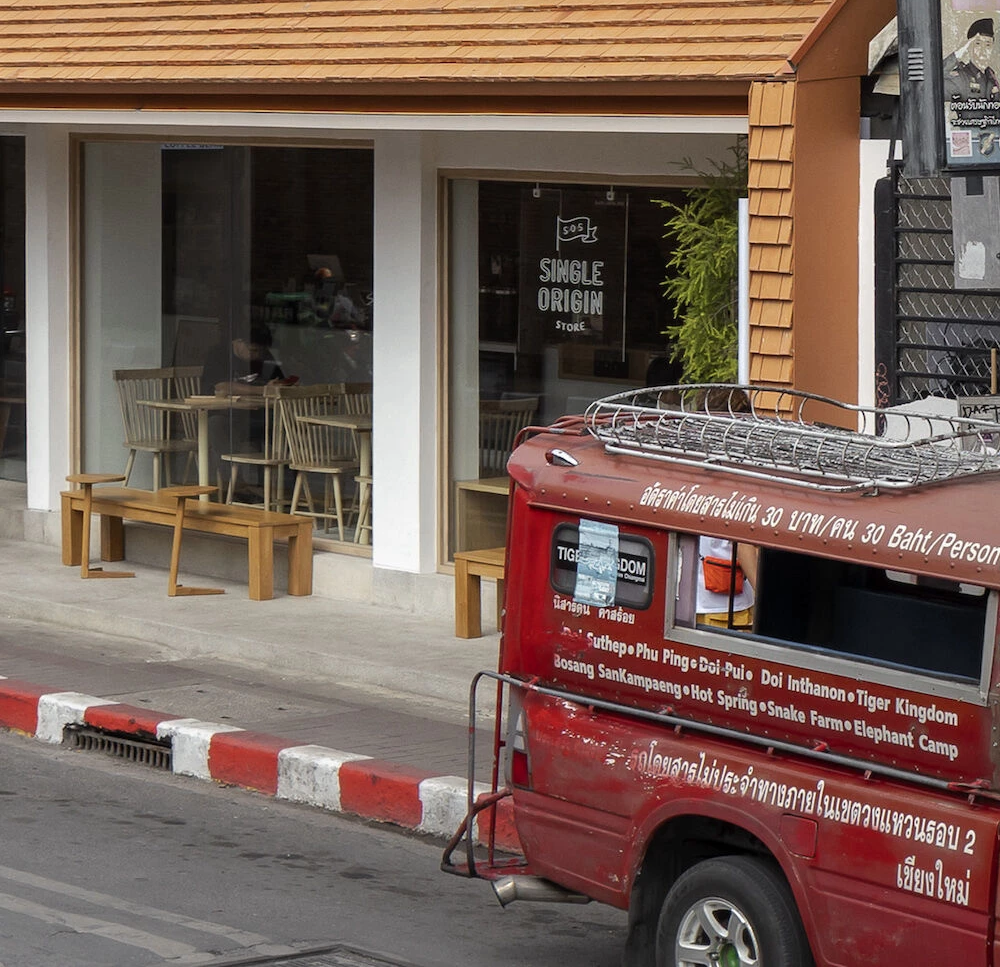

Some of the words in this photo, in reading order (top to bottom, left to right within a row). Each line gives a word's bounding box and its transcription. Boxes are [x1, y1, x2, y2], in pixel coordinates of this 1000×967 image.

[562, 223, 584, 235] SOS
[539, 257, 605, 287] SINGLE
[537, 286, 604, 315] ORIGIN
[555, 319, 586, 333] STORE
[761, 506, 785, 528] 30
[788, 508, 859, 542] บาท/คน
[861, 522, 884, 546] 30
[557, 545, 580, 564] TIGE
[586, 631, 627, 659] Suthep
[635, 641, 659, 663] Phu
[662, 648, 693, 673] Ping
[760, 668, 784, 689] Doi
[787, 674, 846, 703] Inthanon
[855, 689, 892, 713] Tiger
[895, 697, 960, 727] Kingdom
[553, 652, 595, 680] Bosang
[598, 663, 683, 701] SanKampaeng
[690, 684, 714, 704] Hot
[716, 690, 759, 717] Spring
[767, 700, 807, 724] Snake
[809, 709, 845, 733] Farm
[853, 718, 915, 749] Elephant
[918, 733, 960, 762] Camp
[964, 829, 977, 856] 2
[896, 855, 972, 907] เชียงใหม่
